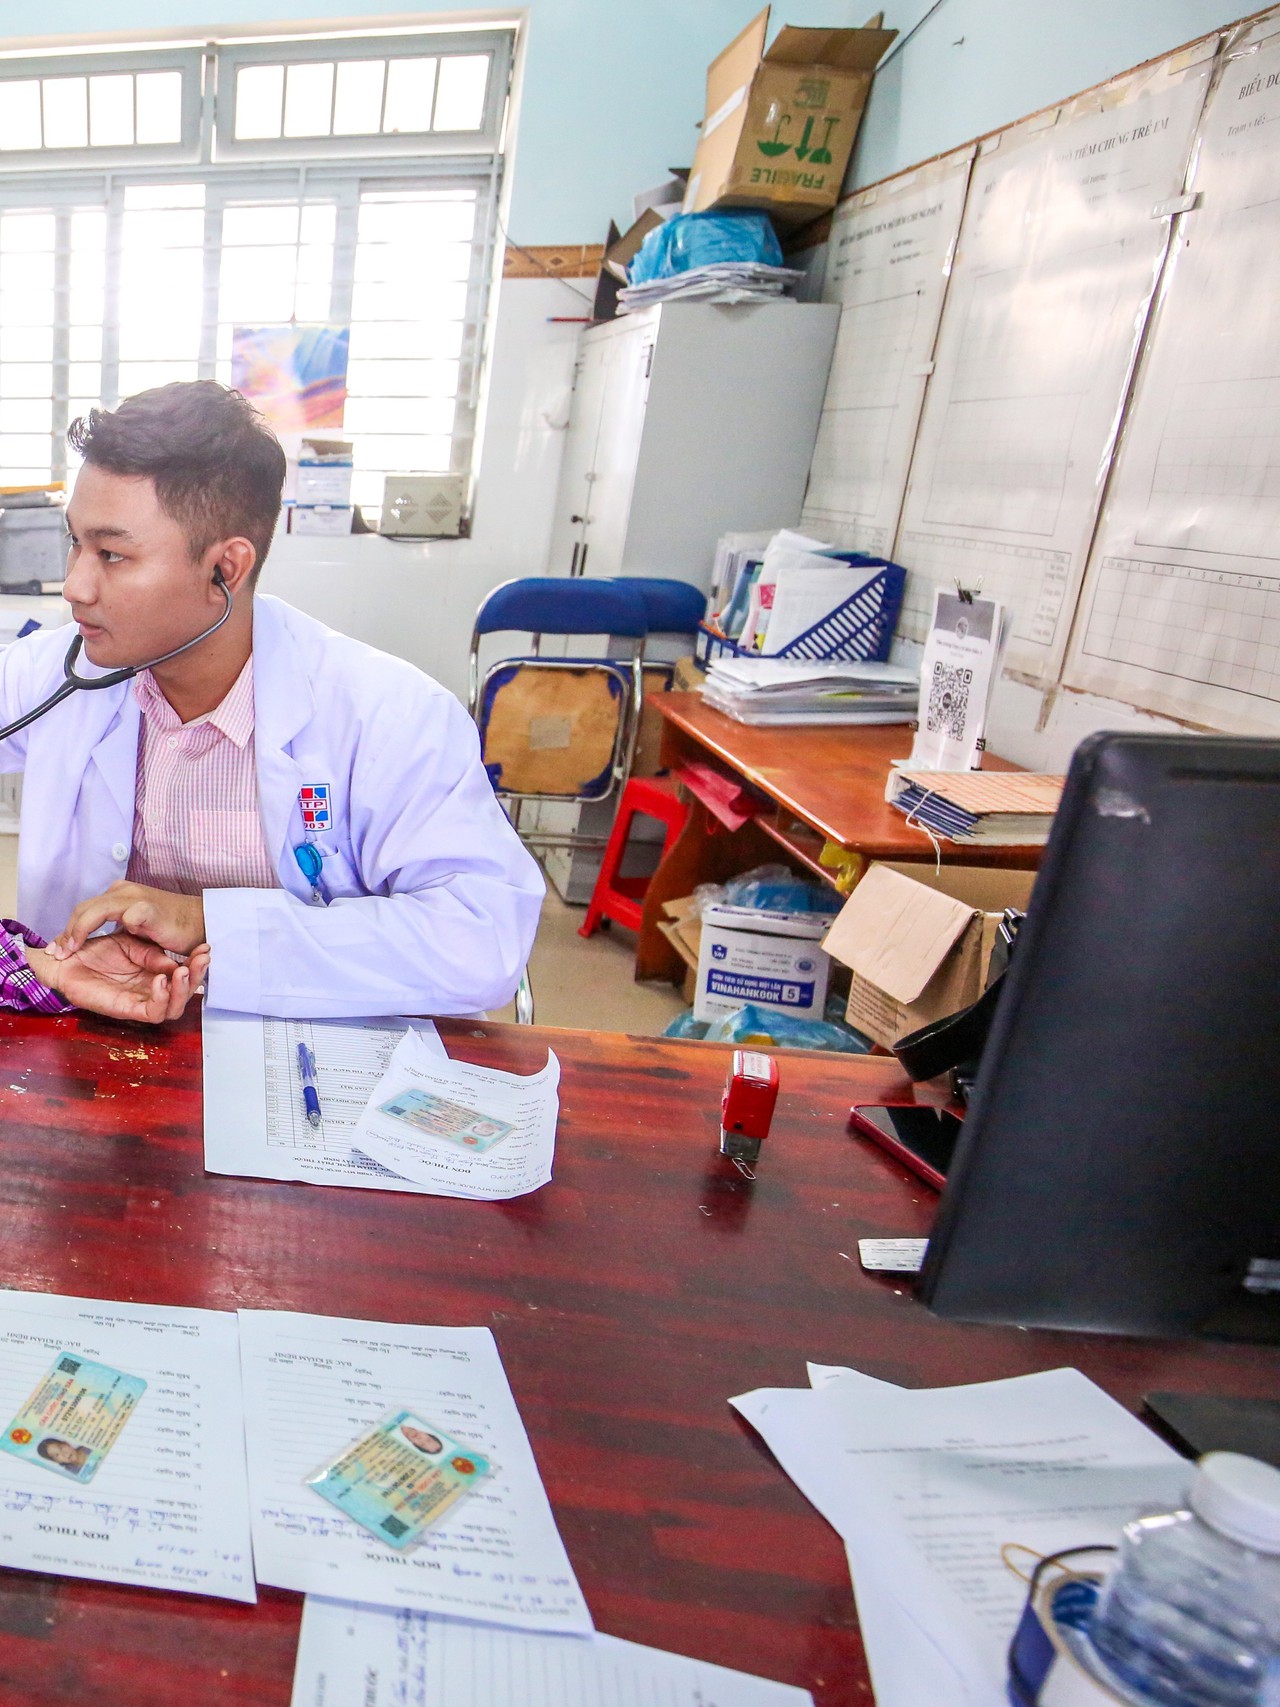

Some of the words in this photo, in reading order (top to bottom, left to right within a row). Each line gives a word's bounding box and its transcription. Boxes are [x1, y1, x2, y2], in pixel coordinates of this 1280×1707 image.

[750, 167, 824, 189] FRAGILE
[711, 982, 780, 1002] VINAHANKOOK
[787, 987, 796, 1000] 5
